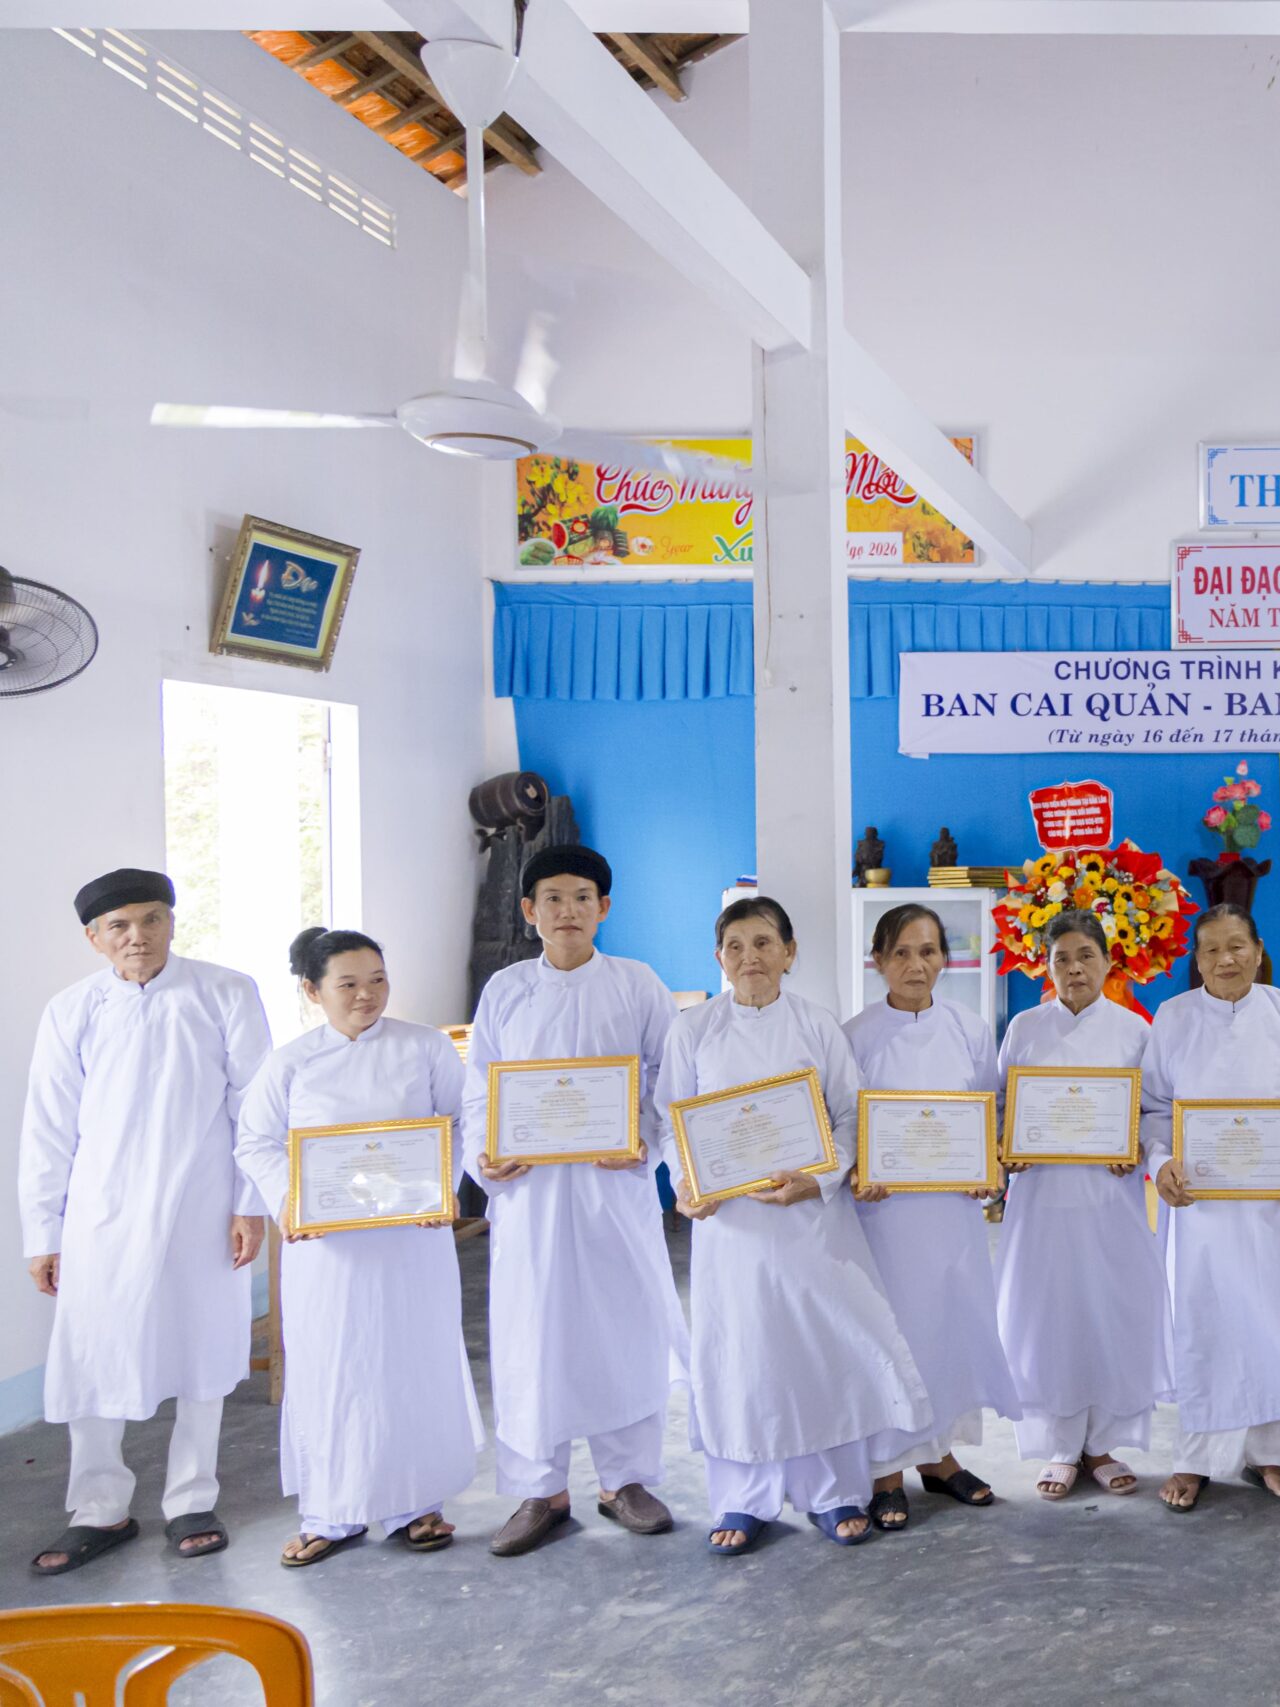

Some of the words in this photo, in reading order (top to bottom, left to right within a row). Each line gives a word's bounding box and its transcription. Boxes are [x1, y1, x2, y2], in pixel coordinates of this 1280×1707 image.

[596, 461, 674, 514] Chúc
[714, 530, 753, 562] Xu
[846, 540, 864, 560] gọ
[868, 541, 898, 557] 2026
[1193, 566, 1233, 602] ĐẠI
[1209, 602, 1260, 628] NĂM
[1054, 657, 1171, 681] CHƯƠNG
[1179, 655, 1262, 680] TRÌNH
[922, 692, 998, 717] BAN
[1010, 692, 1073, 717] CAI
[1085, 682, 1191, 722] QUẢN
[1048, 729, 1083, 746] (Từ
[1088, 730, 1135, 747] ngày
[1143, 729, 1164, 743] 16
[1168, 727, 1204, 743] đến
[1212, 729, 1234, 743] 17
